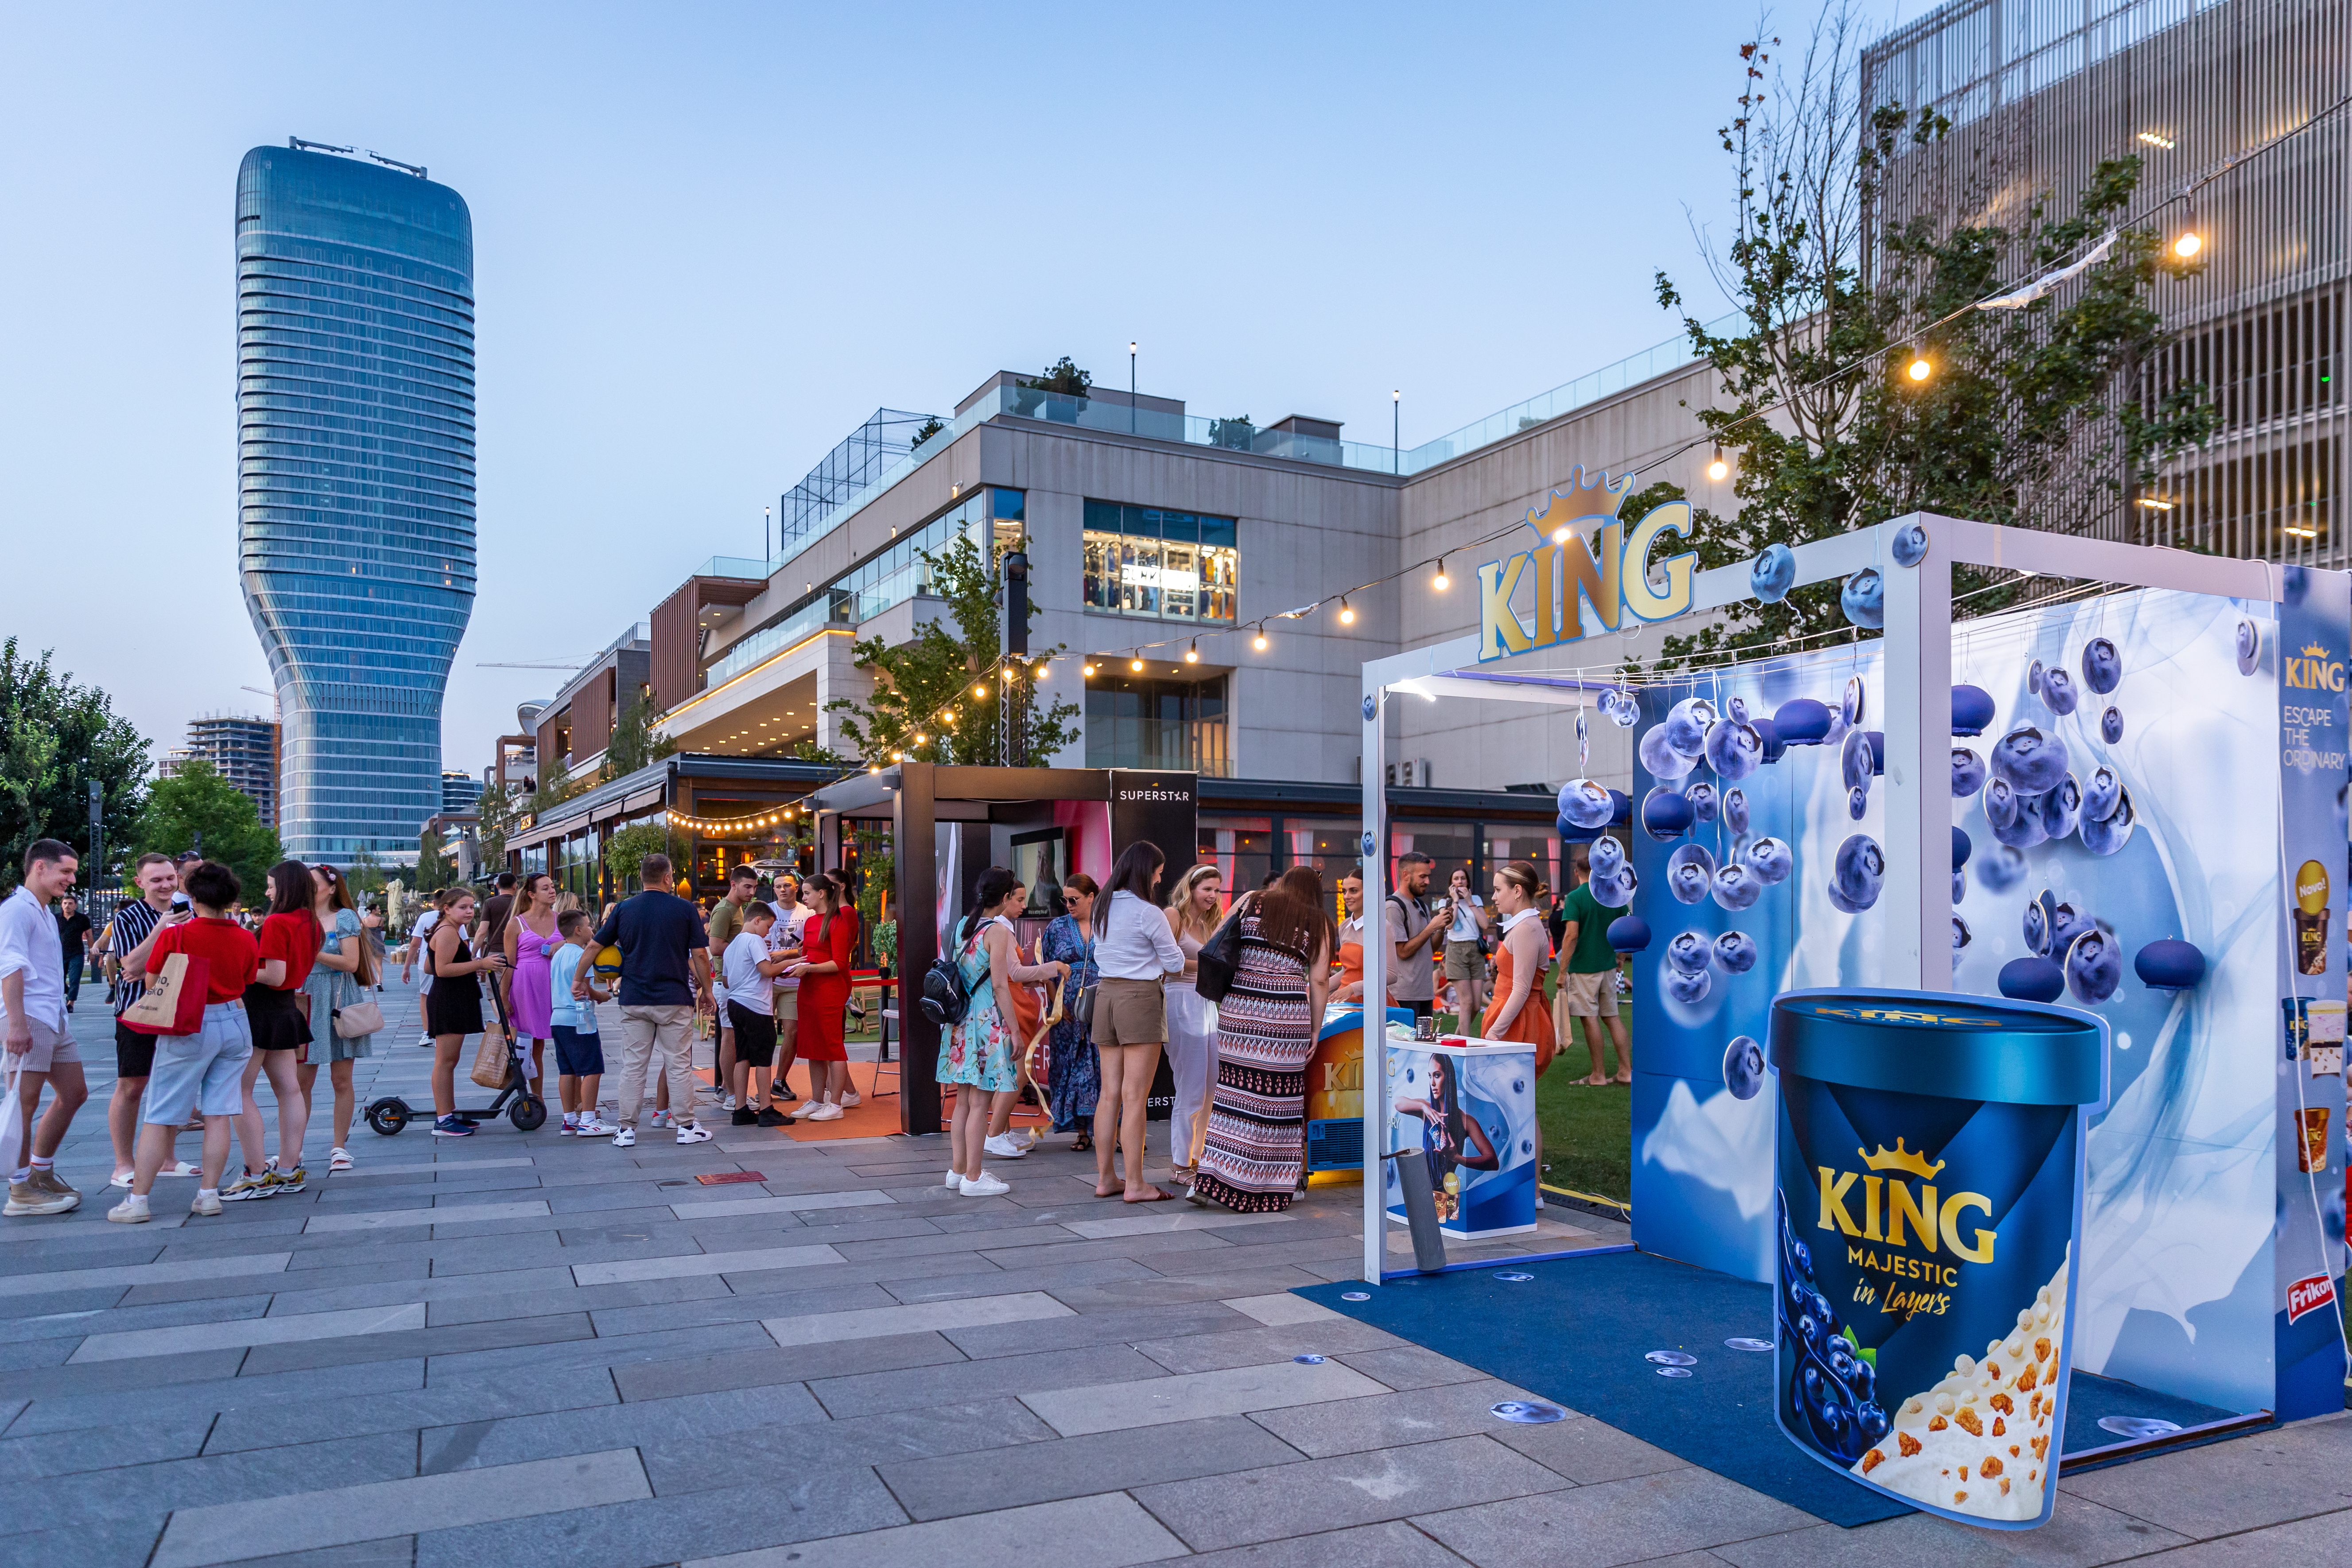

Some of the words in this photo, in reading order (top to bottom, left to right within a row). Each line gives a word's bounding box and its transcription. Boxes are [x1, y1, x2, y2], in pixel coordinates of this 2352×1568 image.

[1478, 501, 1698, 663] KING
[2285, 657, 2345, 692] KING
[2284, 706, 2332, 727] ESCAPE
[2284, 727, 2310, 746] THE
[2283, 749, 2346, 772] ORDINARY
[2299, 877, 2326, 898] Novo!
[2302, 932, 2321, 942] KING
[1815, 1008, 2002, 1027] KING
[2290, 1020, 2308, 1030] KNG
[1324, 1062, 1364, 1091] KI
[2303, 1131, 2322, 1141] ING
[1817, 1166, 1997, 1264] KING
[1848, 1245, 1958, 1287] MAJESTIC
[1853, 1278, 1876, 1305] in
[1881, 1281, 1950, 1321] Layers
